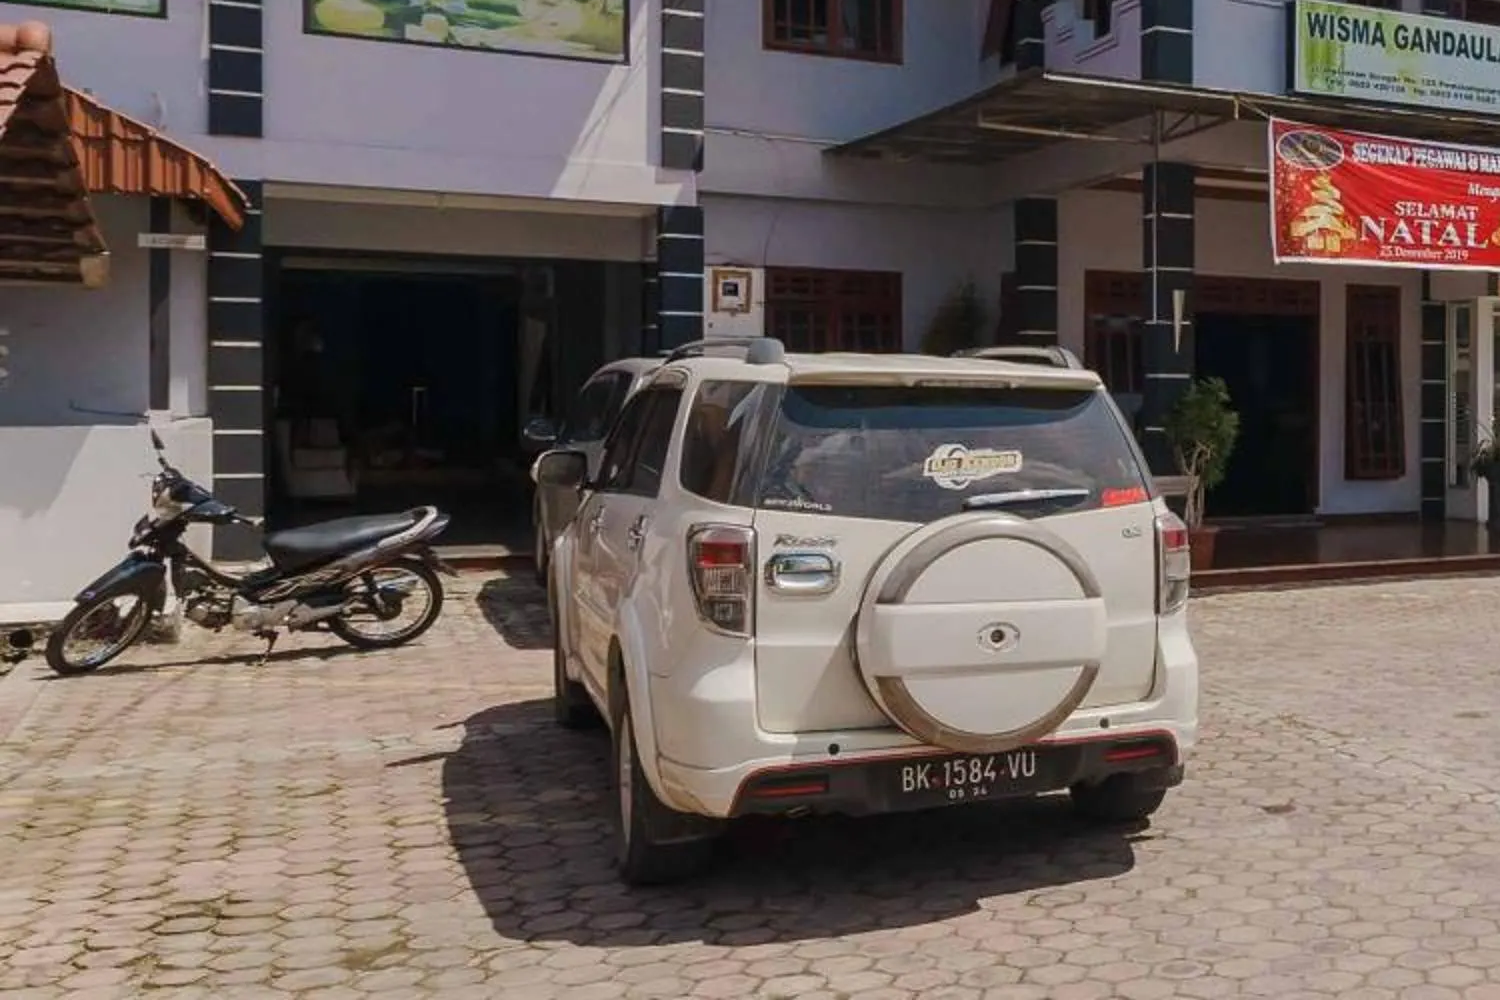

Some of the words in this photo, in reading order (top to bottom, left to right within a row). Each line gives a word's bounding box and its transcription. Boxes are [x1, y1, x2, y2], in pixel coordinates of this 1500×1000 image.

[1306, 11, 1387, 48] WISMA
[1352, 141, 1411, 166] SEGENAP
[1412, 146, 1467, 172] PEGAWAI
[1394, 200, 1480, 220] SELAMAT
[1359, 215, 1489, 249] NATAL
[1444, 247, 1469, 260] 2019
[902, 763, 932, 793] BK
[943, 756, 998, 788] 1584
[1007, 751, 1036, 779] VU
